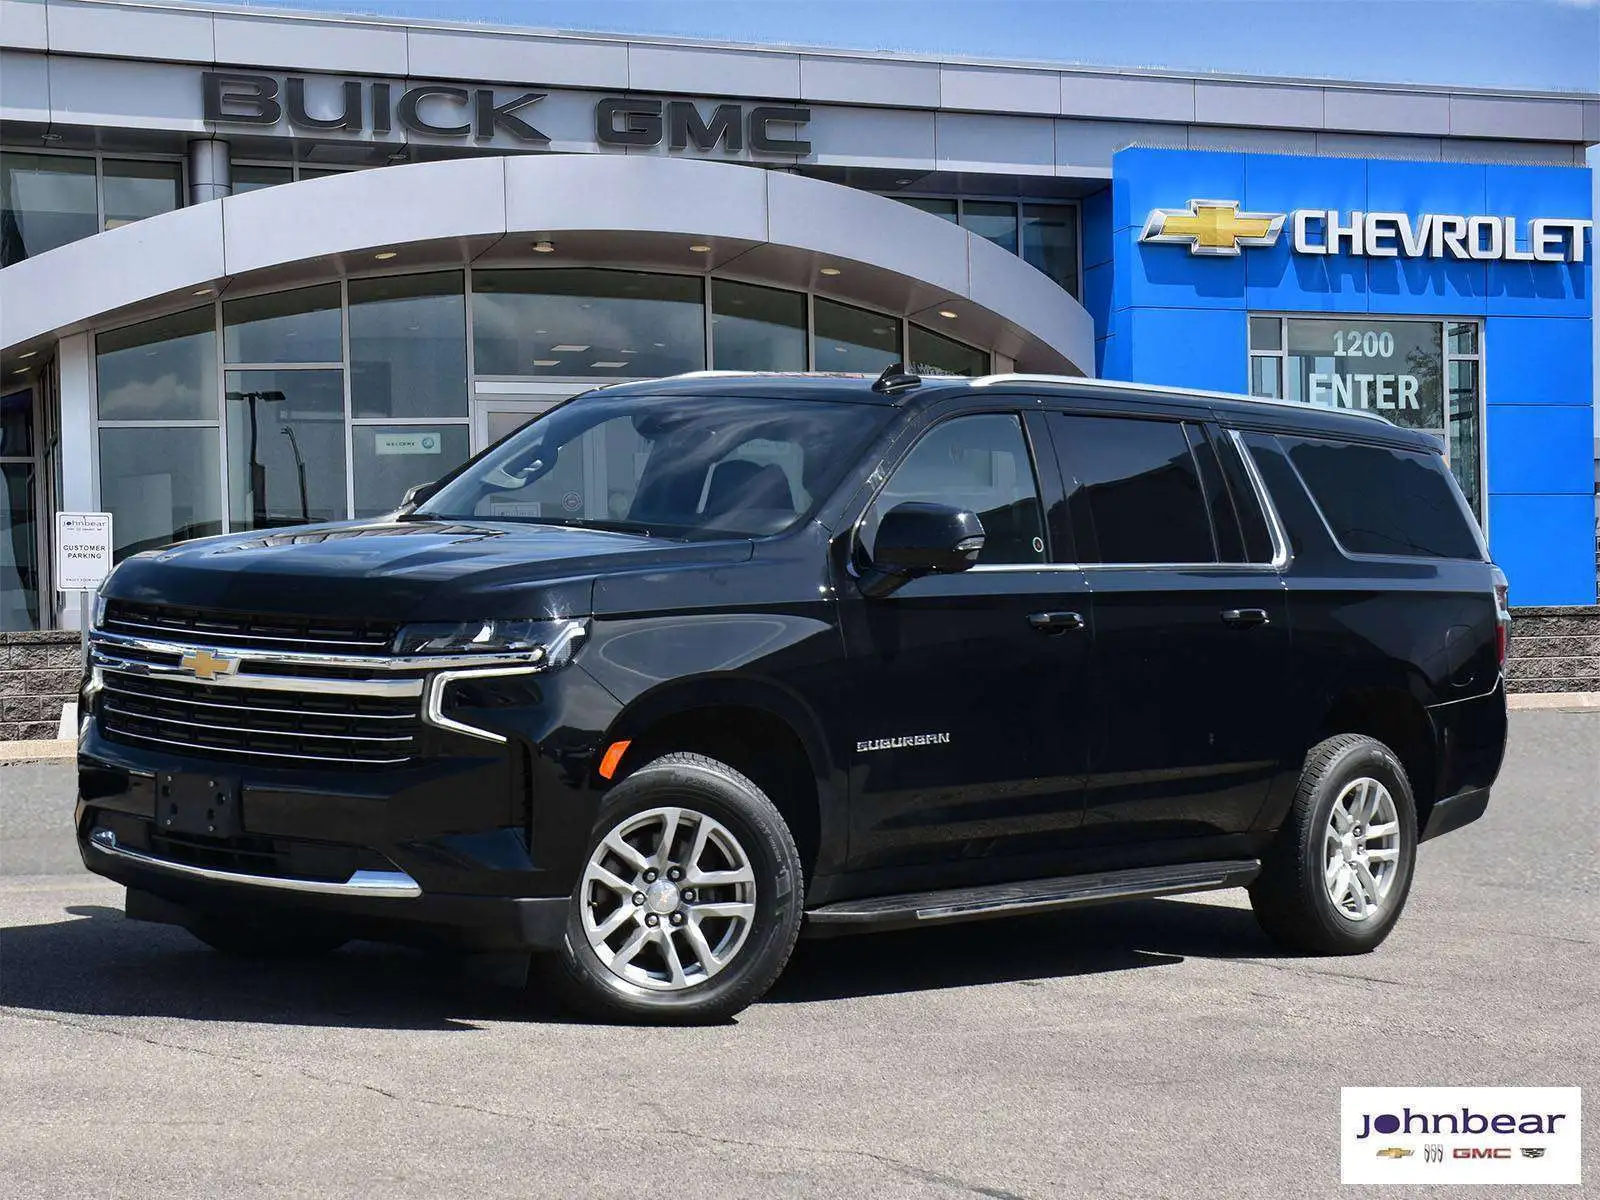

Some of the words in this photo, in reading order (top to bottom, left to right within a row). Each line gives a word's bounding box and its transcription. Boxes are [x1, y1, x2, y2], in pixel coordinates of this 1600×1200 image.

[201, 72, 551, 142] BUICK
[596, 97, 811, 155] GMC
[1291, 208, 1593, 262] CHEVROLET
[1333, 330, 1395, 358] 1200
[1308, 373, 1421, 410] ENTER
[856, 732, 951, 753] SUBURBAN
